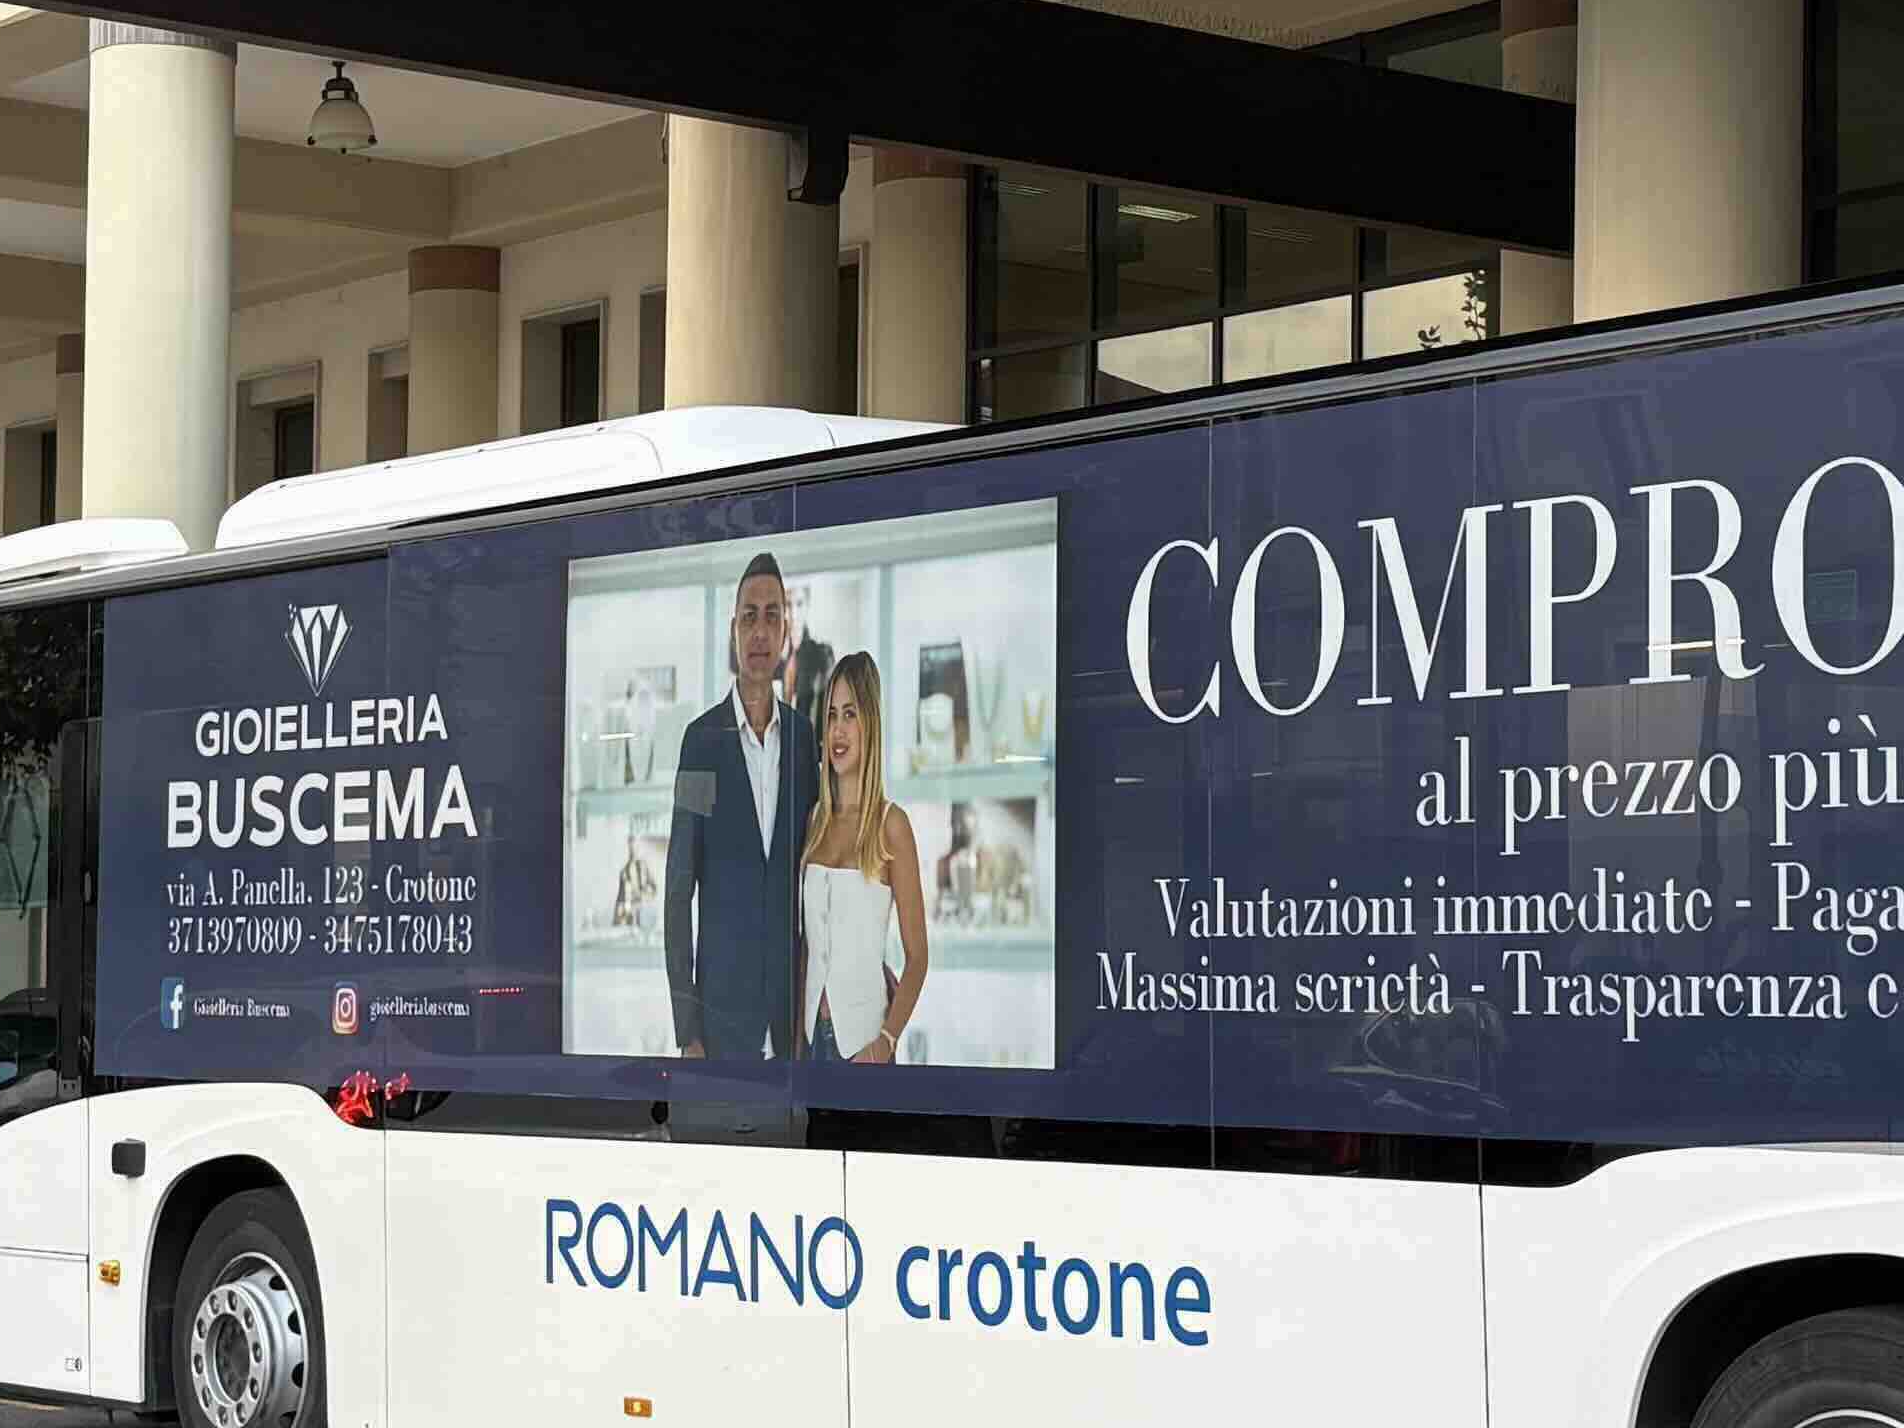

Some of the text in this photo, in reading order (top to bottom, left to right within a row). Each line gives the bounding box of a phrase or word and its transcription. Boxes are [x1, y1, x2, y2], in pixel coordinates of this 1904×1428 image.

[195, 693, 449, 757] GIOIELLERIA
[167, 765, 478, 848] BUSCEMA
[1415, 736, 1476, 827] al
[1499, 753, 1743, 856] prezzo
[167, 873, 195, 906] via
[202, 871, 223, 905] A.
[323, 866, 364, 904] 123
[385, 864, 477, 903] Crotone
[1154, 876, 1416, 939] Valutazioni
[1432, 867, 1713, 937] immediate
[168, 916, 302, 955] 3713970809
[324, 913, 472, 955] 3475178043
[1095, 952, 1280, 1014] Massima
[1295, 953, 1454, 1015] serietà
[1501, 949, 1843, 1043] Trasparenza
[1867, 970, 1898, 1019] e
[545, 1198, 1212, 1347] ROMANO crotone
